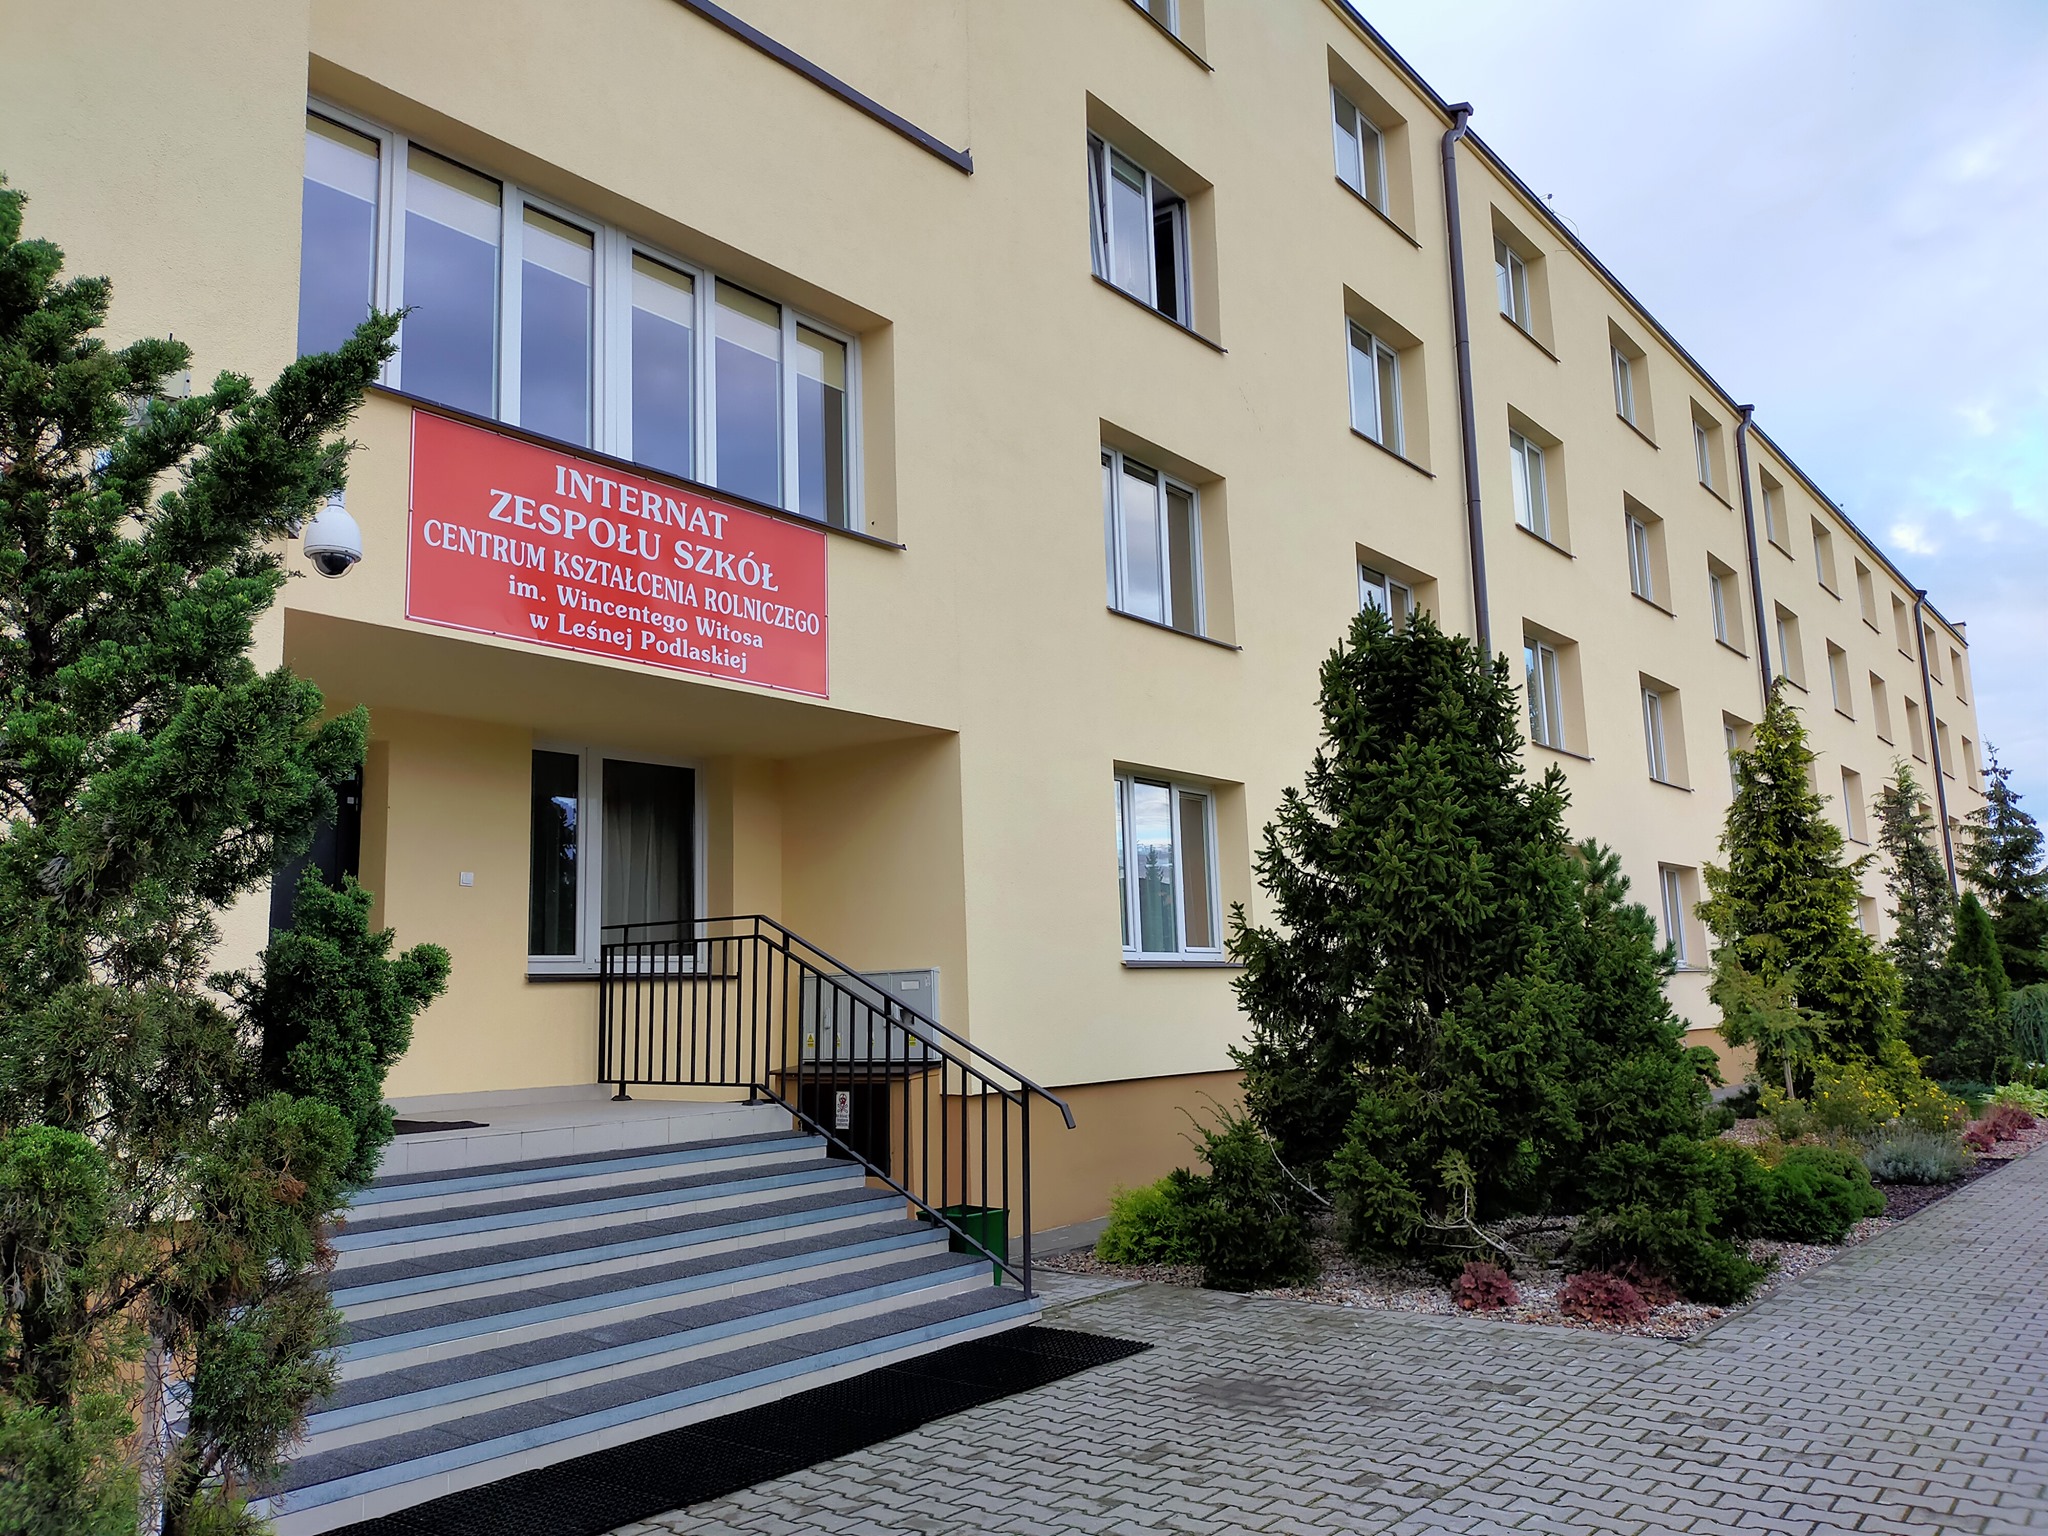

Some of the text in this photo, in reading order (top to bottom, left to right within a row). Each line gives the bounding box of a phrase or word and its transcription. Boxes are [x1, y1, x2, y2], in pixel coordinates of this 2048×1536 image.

[488, 488, 779, 592] ZESPOŁU SZKÓŁ
[555, 465, 728, 540] INTERNAT
[423, 519, 820, 635] CENTRUM KSZTAŁCENIA ROLNICZEGO
[508, 574, 763, 648] im. Wincentego Witosa
[529, 613, 747, 674] w Leśnej Podlaskiej
